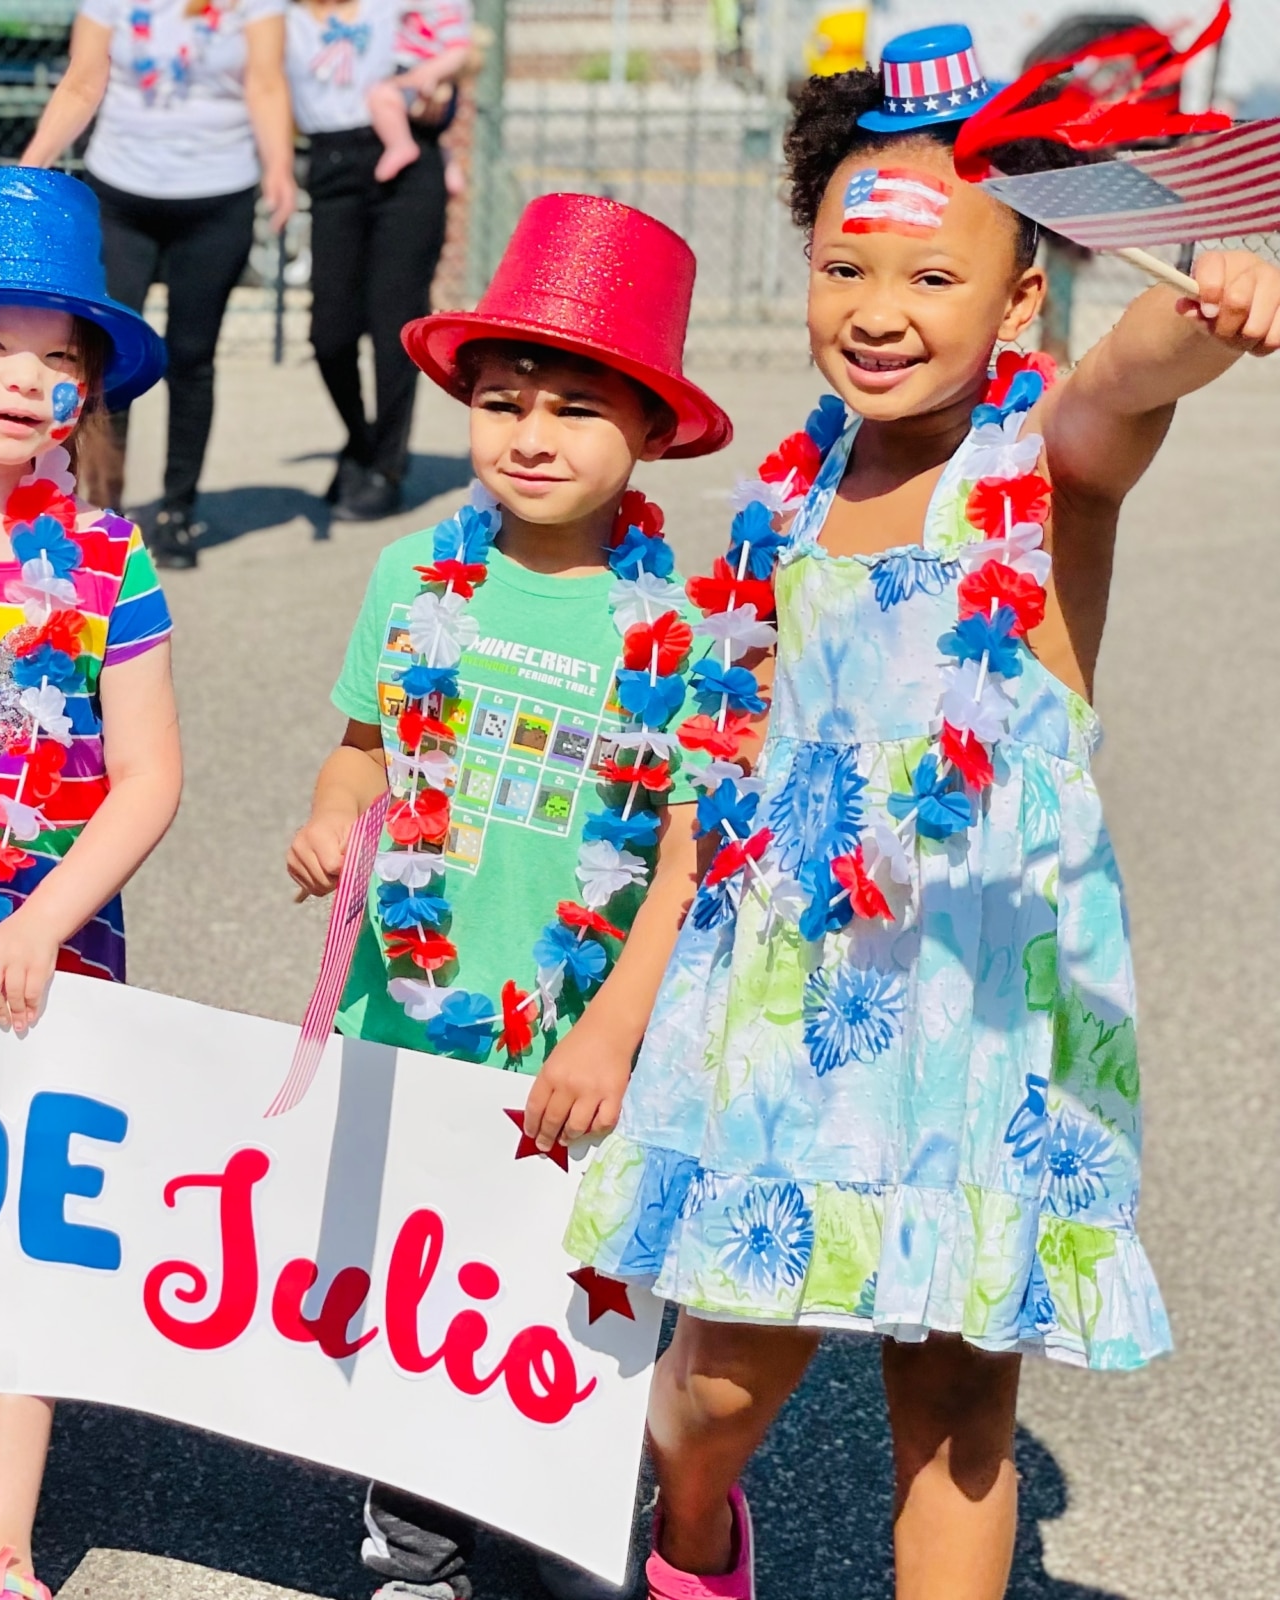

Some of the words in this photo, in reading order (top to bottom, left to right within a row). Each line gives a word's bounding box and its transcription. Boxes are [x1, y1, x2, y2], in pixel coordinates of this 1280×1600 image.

[467, 635, 601, 683] MINECRAFT
[518, 667, 563, 688] PERIODIC
[565, 680, 597, 697] TABLE
[144, 1149, 597, 1424] Julio
